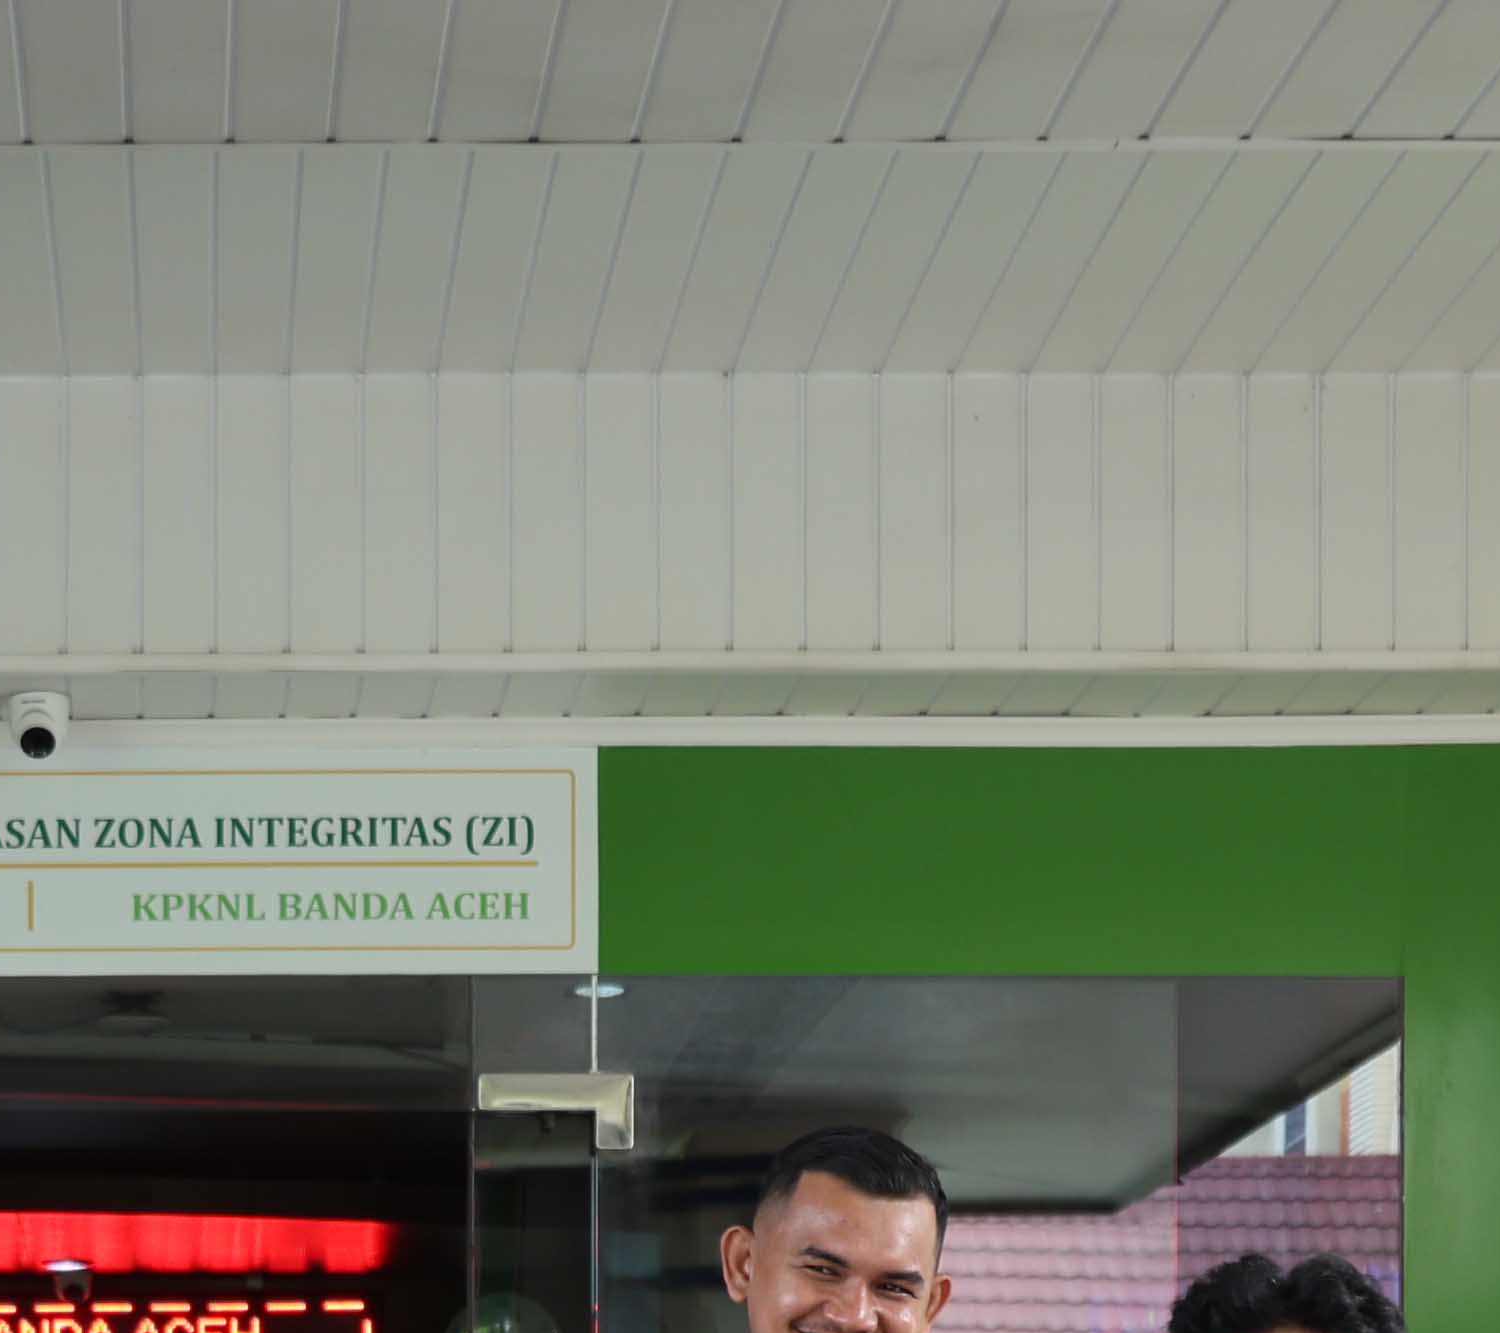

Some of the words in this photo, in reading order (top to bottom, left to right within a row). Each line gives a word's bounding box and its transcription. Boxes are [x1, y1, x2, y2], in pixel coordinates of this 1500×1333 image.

[93, 817, 201, 849] ZONA
[214, 816, 453, 848] INTEGRITAS
[465, 815, 535, 855] (ZI)
[131, 893, 266, 923] KPKNL
[277, 892, 416, 922] BANDA
[425, 891, 530, 921] ACEH
